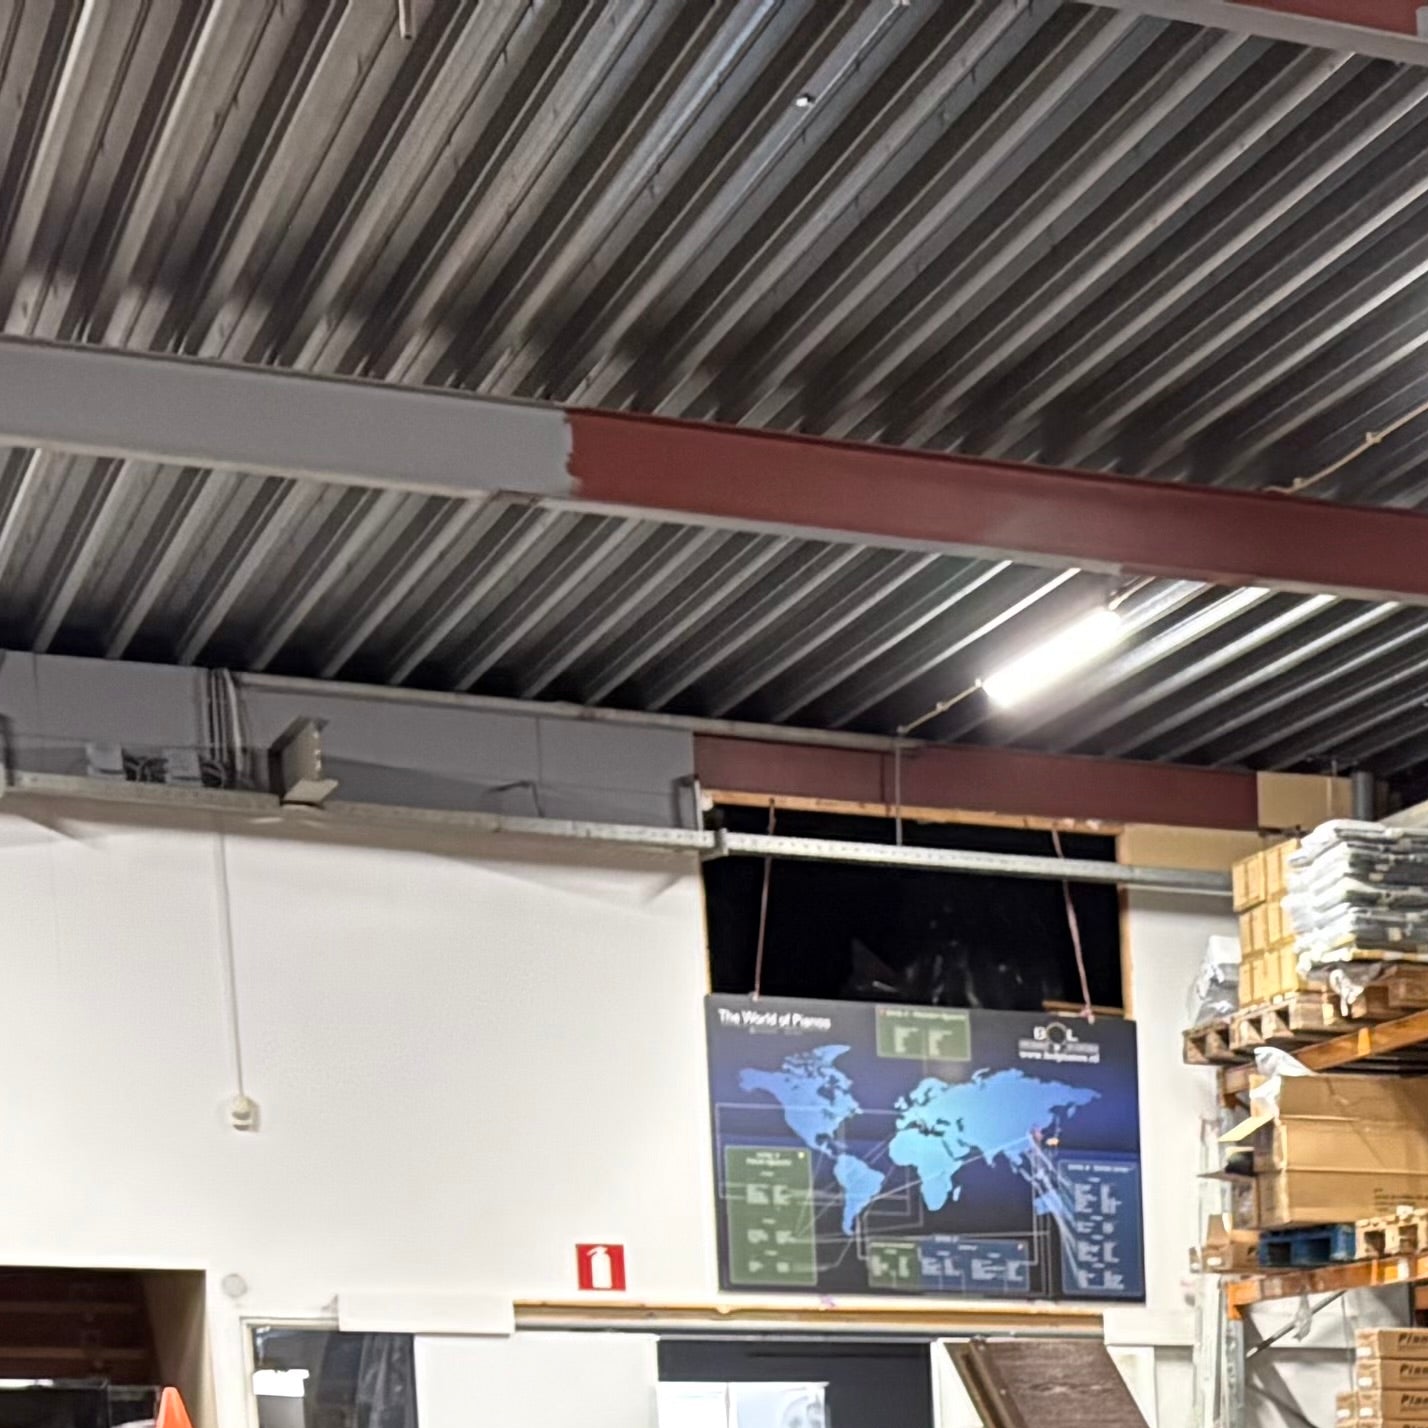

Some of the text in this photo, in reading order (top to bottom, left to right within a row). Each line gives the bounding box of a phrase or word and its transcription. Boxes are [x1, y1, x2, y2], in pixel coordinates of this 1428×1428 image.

[718, 1008, 741, 1024] The
[742, 1010, 777, 1027] World
[779, 1013, 791, 1027] of
[792, 1013, 832, 1031] Pianos
